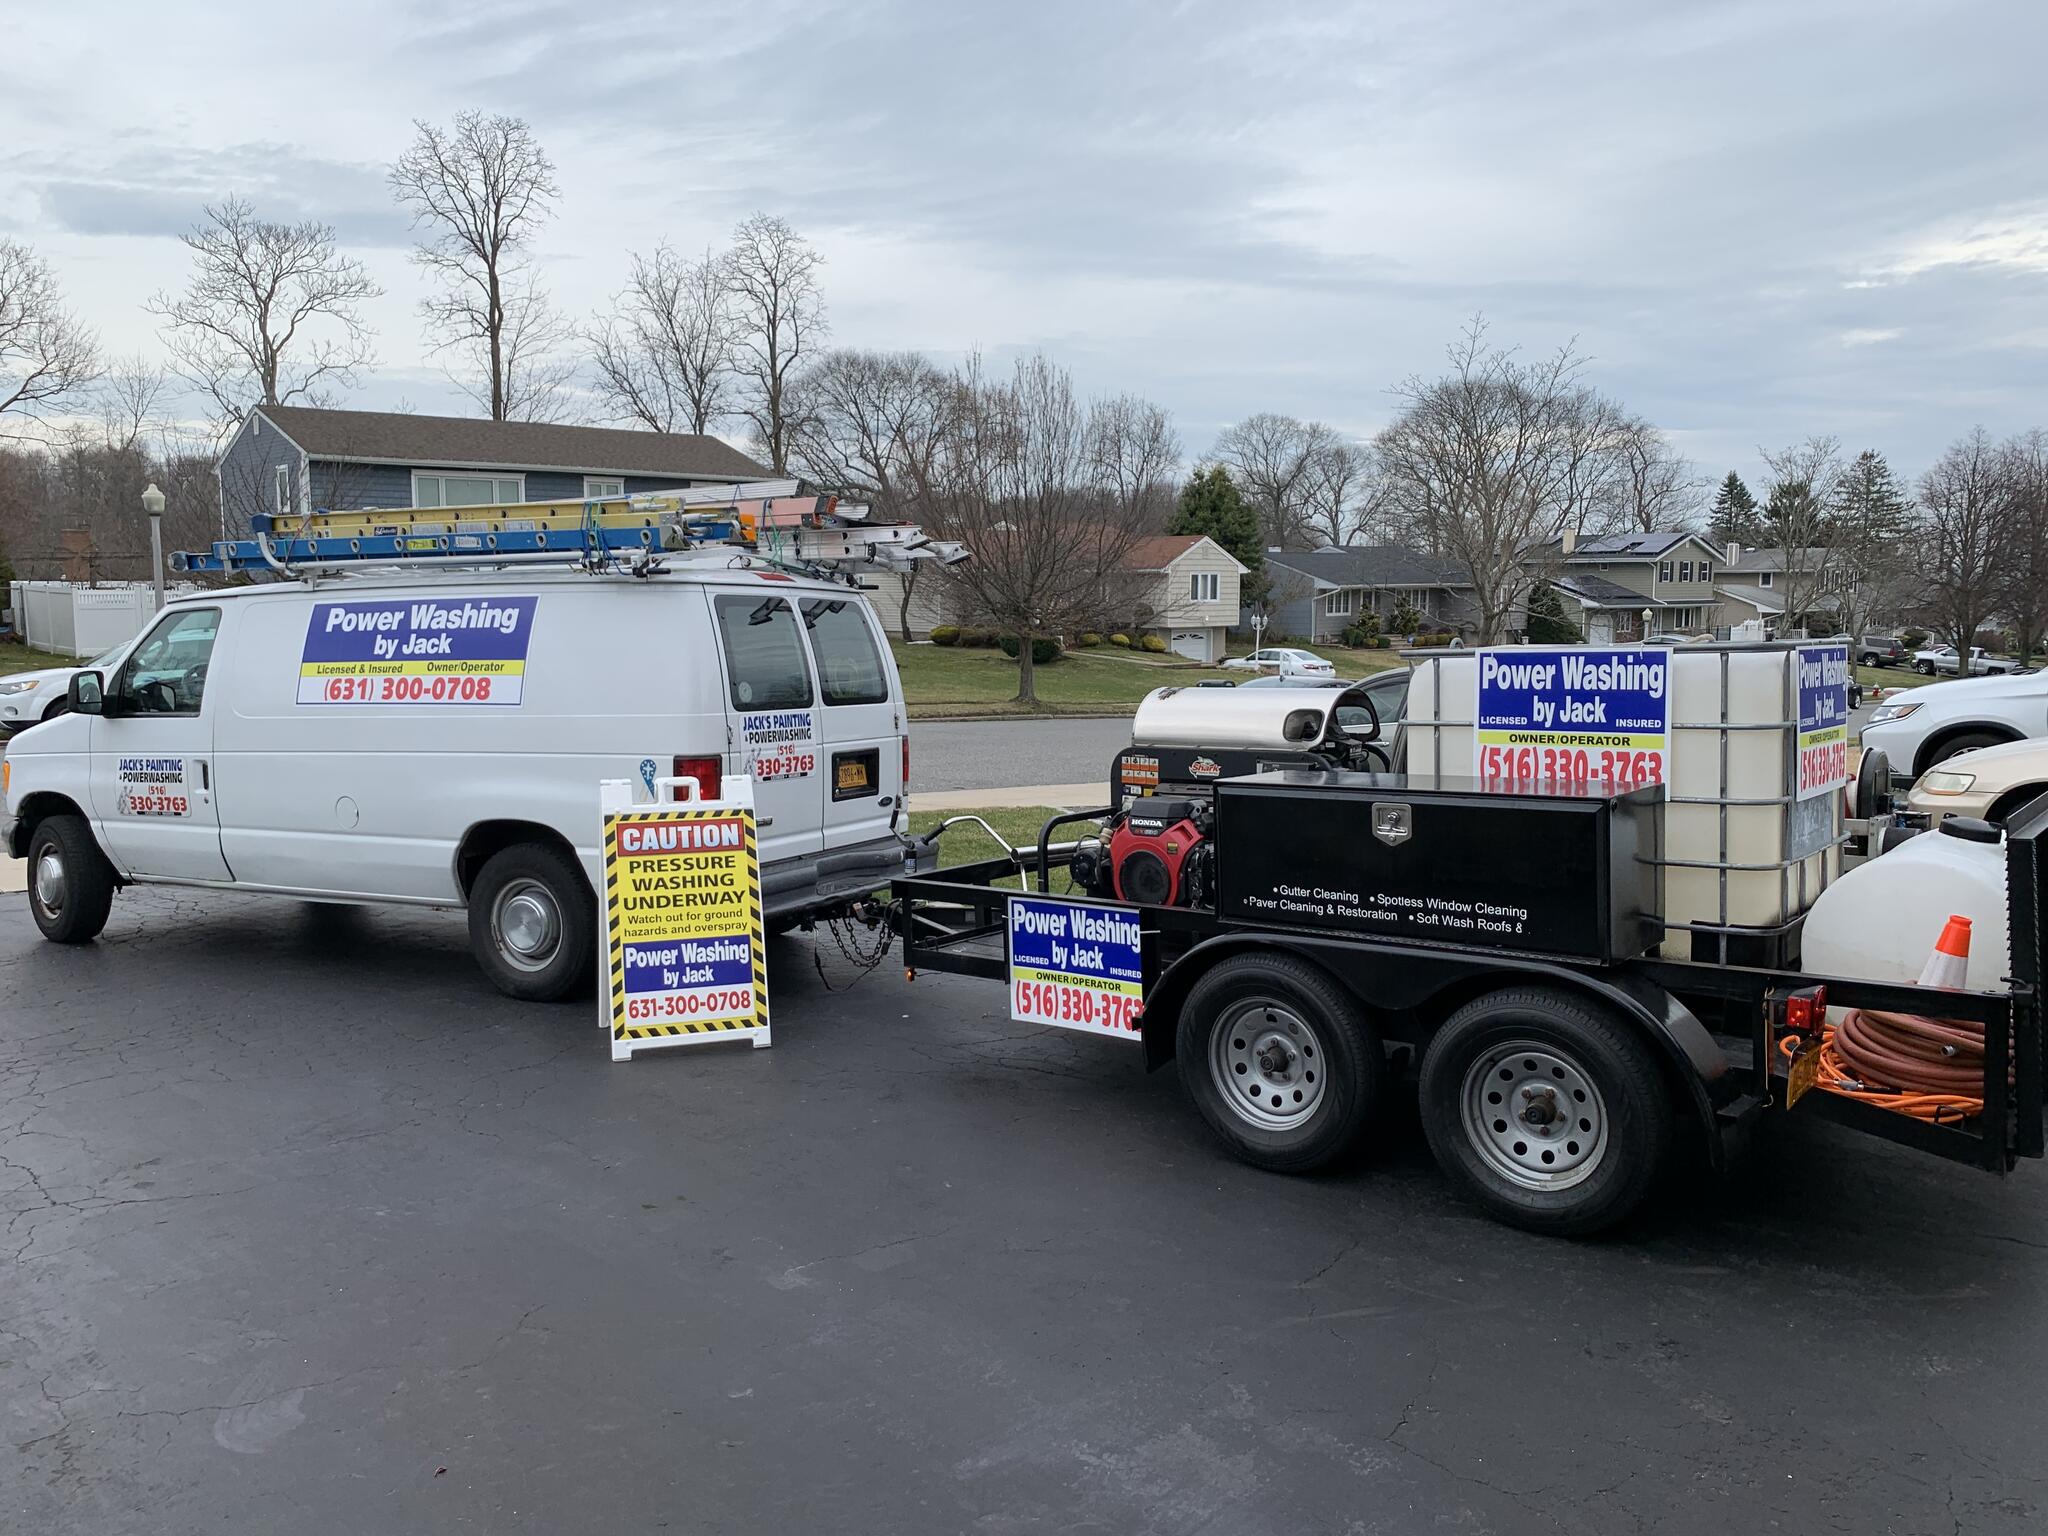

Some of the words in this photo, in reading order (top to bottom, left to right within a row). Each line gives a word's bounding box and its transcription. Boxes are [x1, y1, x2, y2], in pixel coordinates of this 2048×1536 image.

[325, 608, 404, 632] Power
[410, 602, 520, 634] Washing
[374, 635, 400, 659] by
[402, 633, 453, 654] Jack
[317, 664, 356, 674] Licensed
[359, 664, 366, 673] &
[368, 663, 403, 673] Insured
[427, 661, 505, 672] Owner/Operator
[1800, 654, 1821, 689] Power
[1482, 656, 1555, 690] Power
[1561, 655, 1664, 698] Washing
[324, 678, 374, 701] (631)
[381, 677, 492, 700] 300-0708
[1481, 716, 1528, 725] LICENSED
[1533, 695, 1555, 728] by
[1560, 695, 1607, 723] Jack
[743, 716, 771, 731] JACK'S
[774, 713, 811, 728] PAINTING
[1615, 718, 1662, 728] INSURED
[749, 728, 812, 744] POWERWASHING
[1509, 734, 1631, 746] OWNER/OPERATOR
[777, 744, 795, 756] (516)
[119, 759, 144, 771] JACK'S
[146, 759, 183, 771] PAINTING
[757, 754, 814, 776] 330-3763
[1192, 762, 1220, 772] Shark
[1480, 745, 1539, 779] (516)
[1544, 748, 1662, 785] 330-3763
[123, 772, 183, 783] POWERWASHING
[148, 785, 166, 795] (516)
[129, 796, 187, 811] 330-3763
[1131, 818, 1163, 827] HONDA
[622, 823, 739, 851] CAUTION
[629, 855, 736, 873] PRESSURE
[632, 873, 735, 891] WASHING
[623, 890, 746, 910] UNDERWAY
[1279, 885, 1311, 897] Gutter
[1313, 888, 1359, 903] Cleaning
[1249, 896, 1278, 909] Paver
[1279, 899, 1324, 916] Cleaning
[1326, 904, 1334, 915] &
[1337, 904, 1398, 921] Restoration
[1377, 893, 1423, 907] Spotless
[1426, 898, 1472, 912] Window
[1475, 902, 1527, 920] Cleaning
[627, 913, 662, 925] Watch
[665, 912, 683, 923] out
[686, 911, 701, 921] for
[704, 909, 743, 922] ground
[1416, 913, 1439, 925] Soft
[1442, 915, 1474, 928] Wash
[1477, 918, 1512, 932] Roofs
[1515, 922, 1523, 934] &
[624, 925, 668, 937] hazards
[671, 923, 692, 934] and
[694, 921, 748, 934] overspray
[1013, 903, 1067, 936] Power
[1070, 909, 1141, 953] Washing
[625, 945, 678, 968] Power
[681, 940, 749, 964] Washing
[1014, 954, 1049, 965] LICENSED
[1052, 940, 1068, 970] by
[1071, 943, 1104, 970] Jack
[663, 968, 680, 988] by
[682, 965, 714, 984] Jack
[1036, 972, 1121, 991] OWNER/OPERATOR
[1110, 967, 1142, 979] INSURED
[628, 990, 751, 1019] 631-300-0708
[1016, 980, 1059, 1020] (516)
